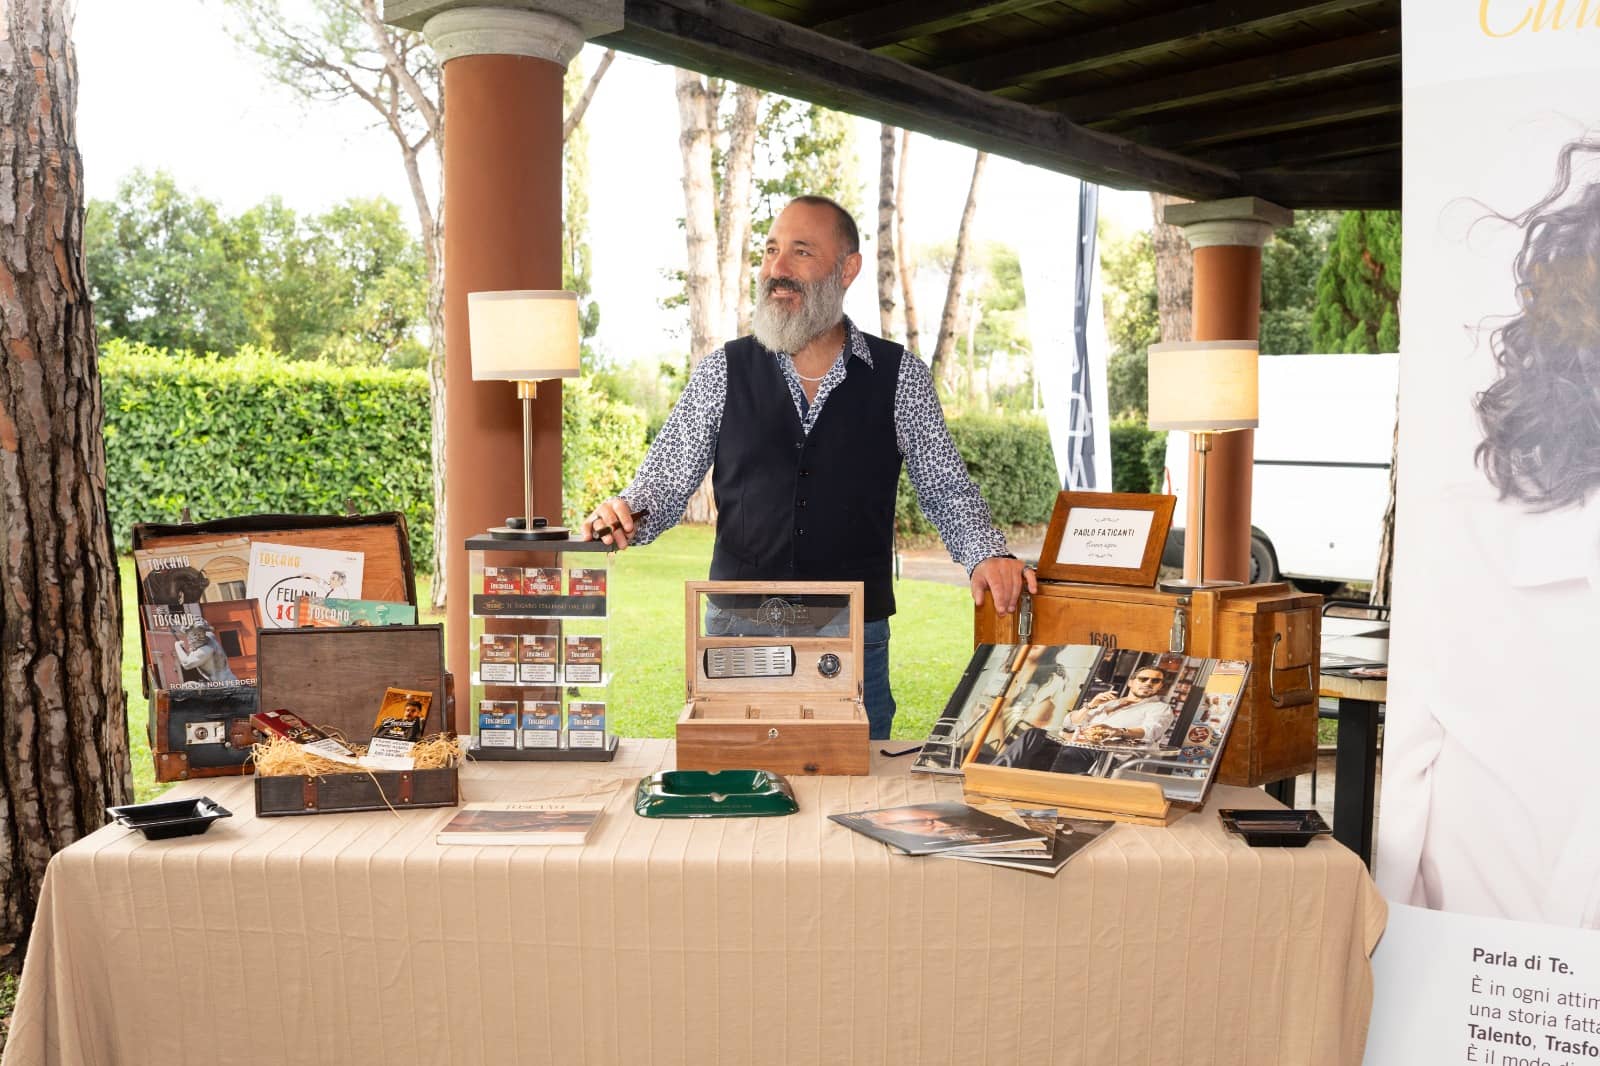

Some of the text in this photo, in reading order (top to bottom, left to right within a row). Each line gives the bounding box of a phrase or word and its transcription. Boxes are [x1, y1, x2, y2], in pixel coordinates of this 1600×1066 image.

[1073, 528, 1135, 538] PAOLO FATICANTI
[147, 555, 191, 571] TOSCANO
[258, 551, 302, 567] TOSCANO
[152, 612, 195, 627] TOSCANO
[309, 606, 350, 621] TOSCANO
[207, 680, 224, 688] NON
[226, 678, 257, 687] PERDER
[1472, 947, 1574, 975] Parla di Te.
[1471, 974, 1482, 994] È
[1490, 980, 1505, 997] in
[1512, 987, 1550, 1004] ogni
[1470, 1004, 1501, 1019] una
[1508, 1008, 1557, 1027] storia
[1467, 1023, 1600, 1058] Talento, Trasfo
[1467, 1043, 1478, 1062] È
[1485, 1048, 1495, 1065] il
